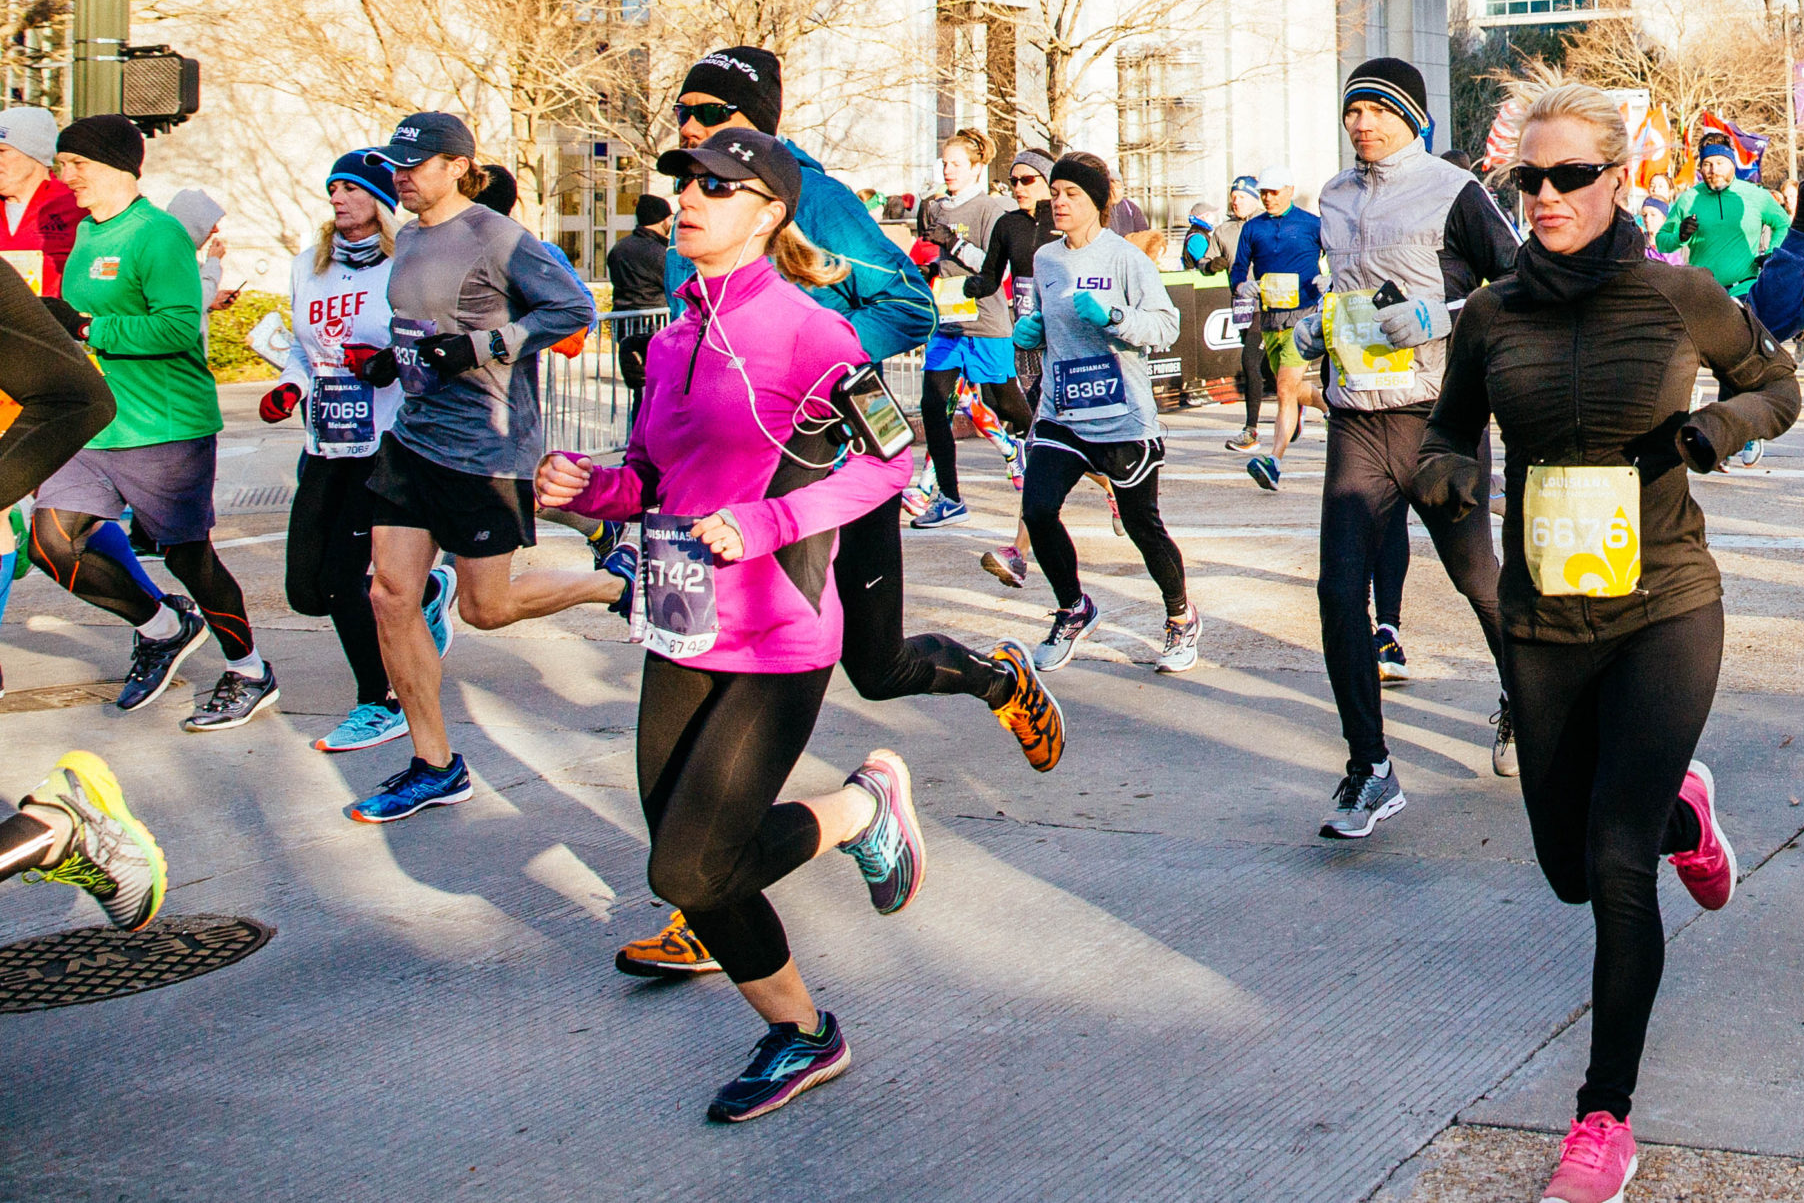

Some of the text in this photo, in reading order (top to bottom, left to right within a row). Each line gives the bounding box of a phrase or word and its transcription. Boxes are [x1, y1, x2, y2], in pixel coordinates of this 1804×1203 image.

[1076, 277, 1112, 291] LSU
[309, 291, 369, 326] BEEF
[1066, 378, 1119, 400] 8367
[320, 401, 369, 419] 7069
[1531, 517, 1629, 549] 6676
[647, 559, 705, 594] 742
[668, 639, 709, 654] 8742
